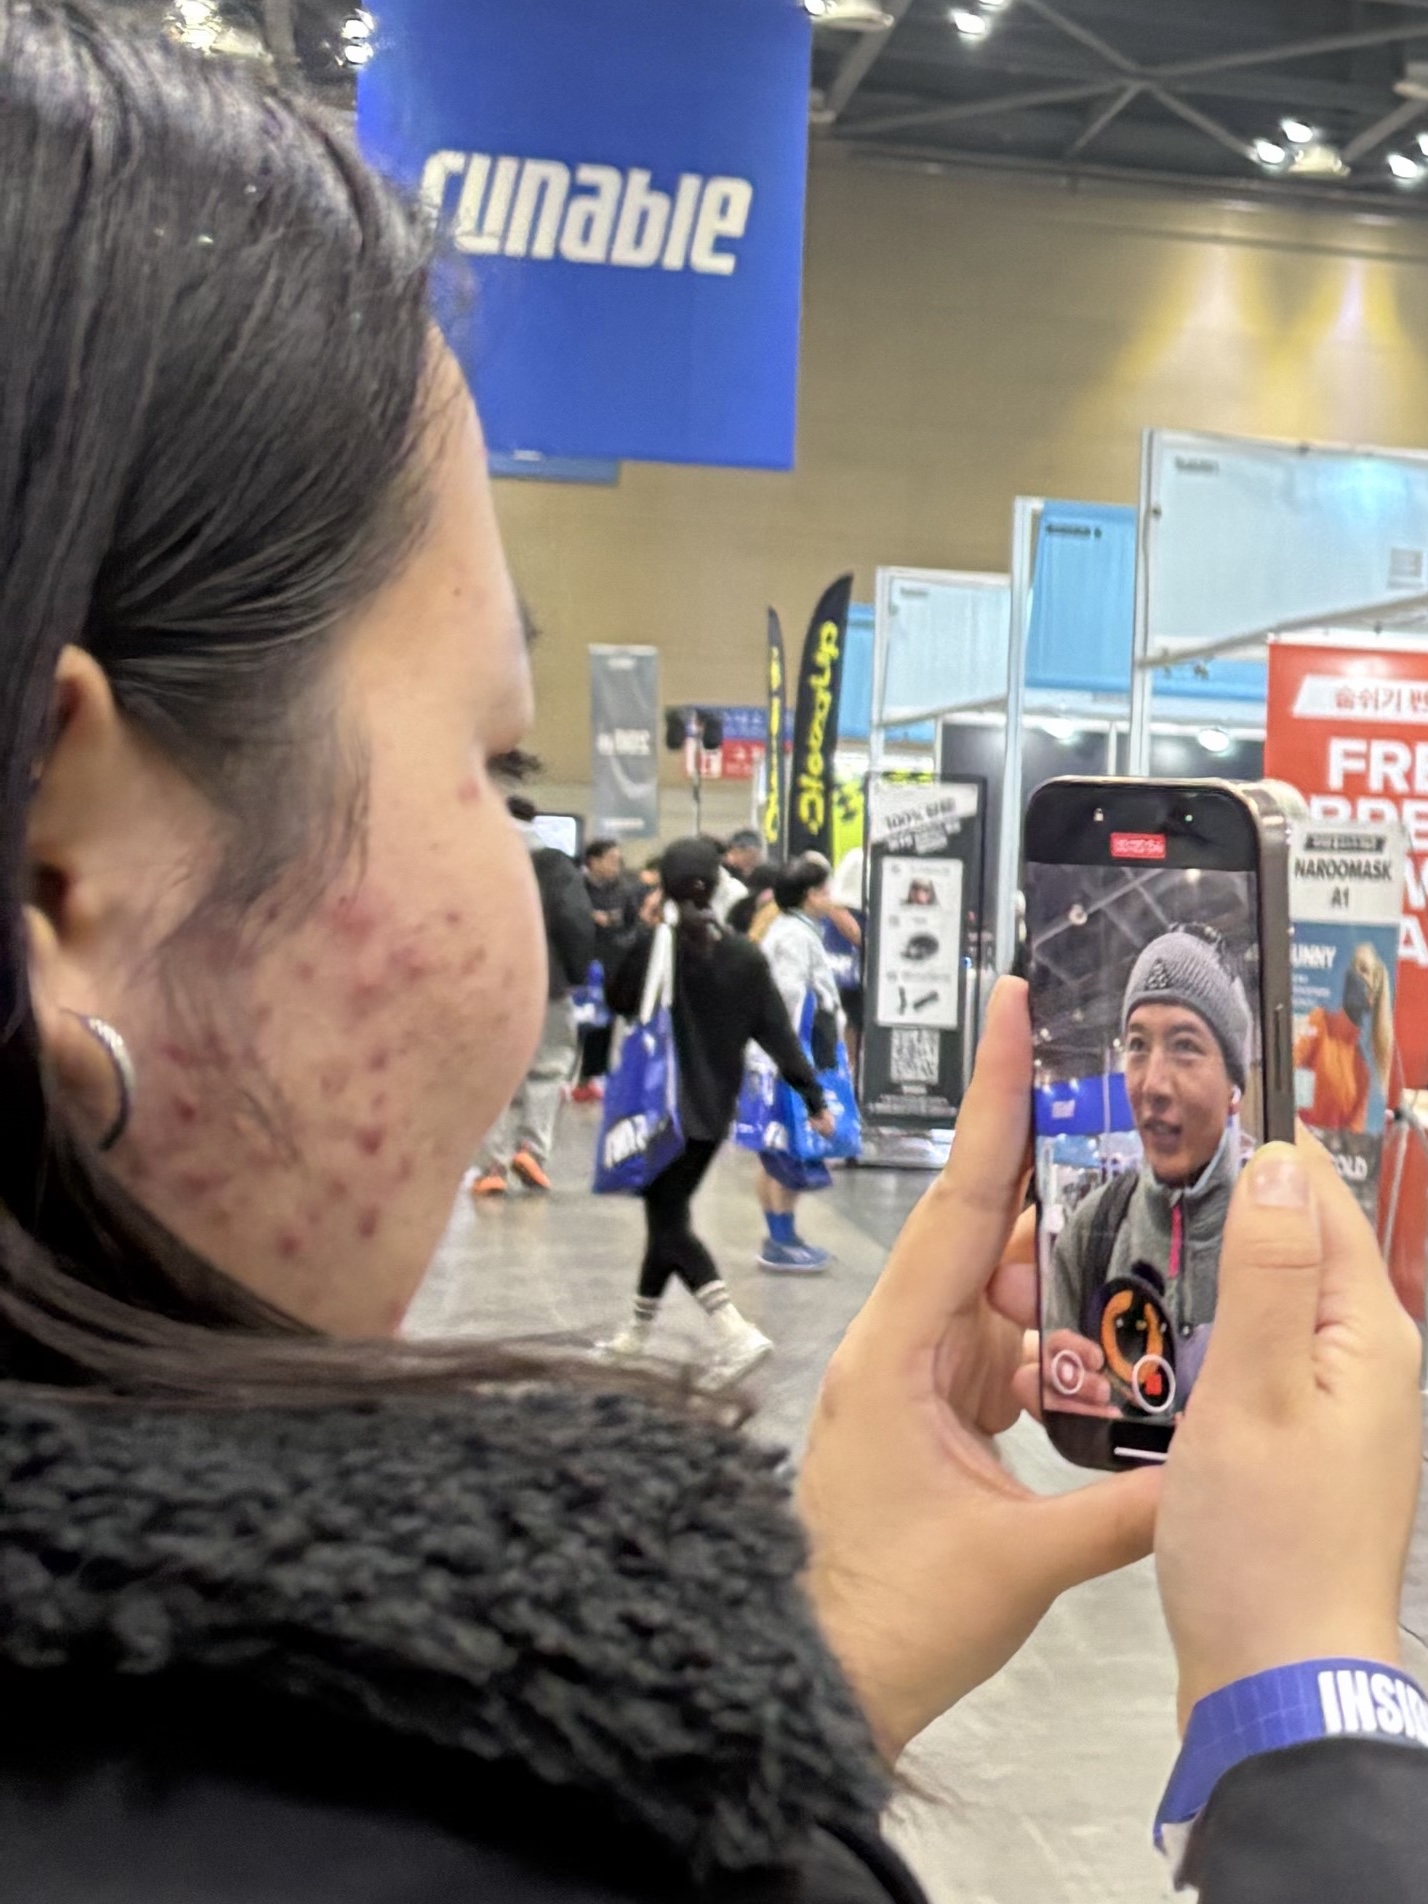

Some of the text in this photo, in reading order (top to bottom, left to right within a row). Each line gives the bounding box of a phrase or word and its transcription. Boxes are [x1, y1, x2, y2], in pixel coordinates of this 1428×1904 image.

[421, 149, 754, 276] runable
[1294, 857, 1392, 881] NAROOMASK
[1291, 943, 1337, 969] UNNY
